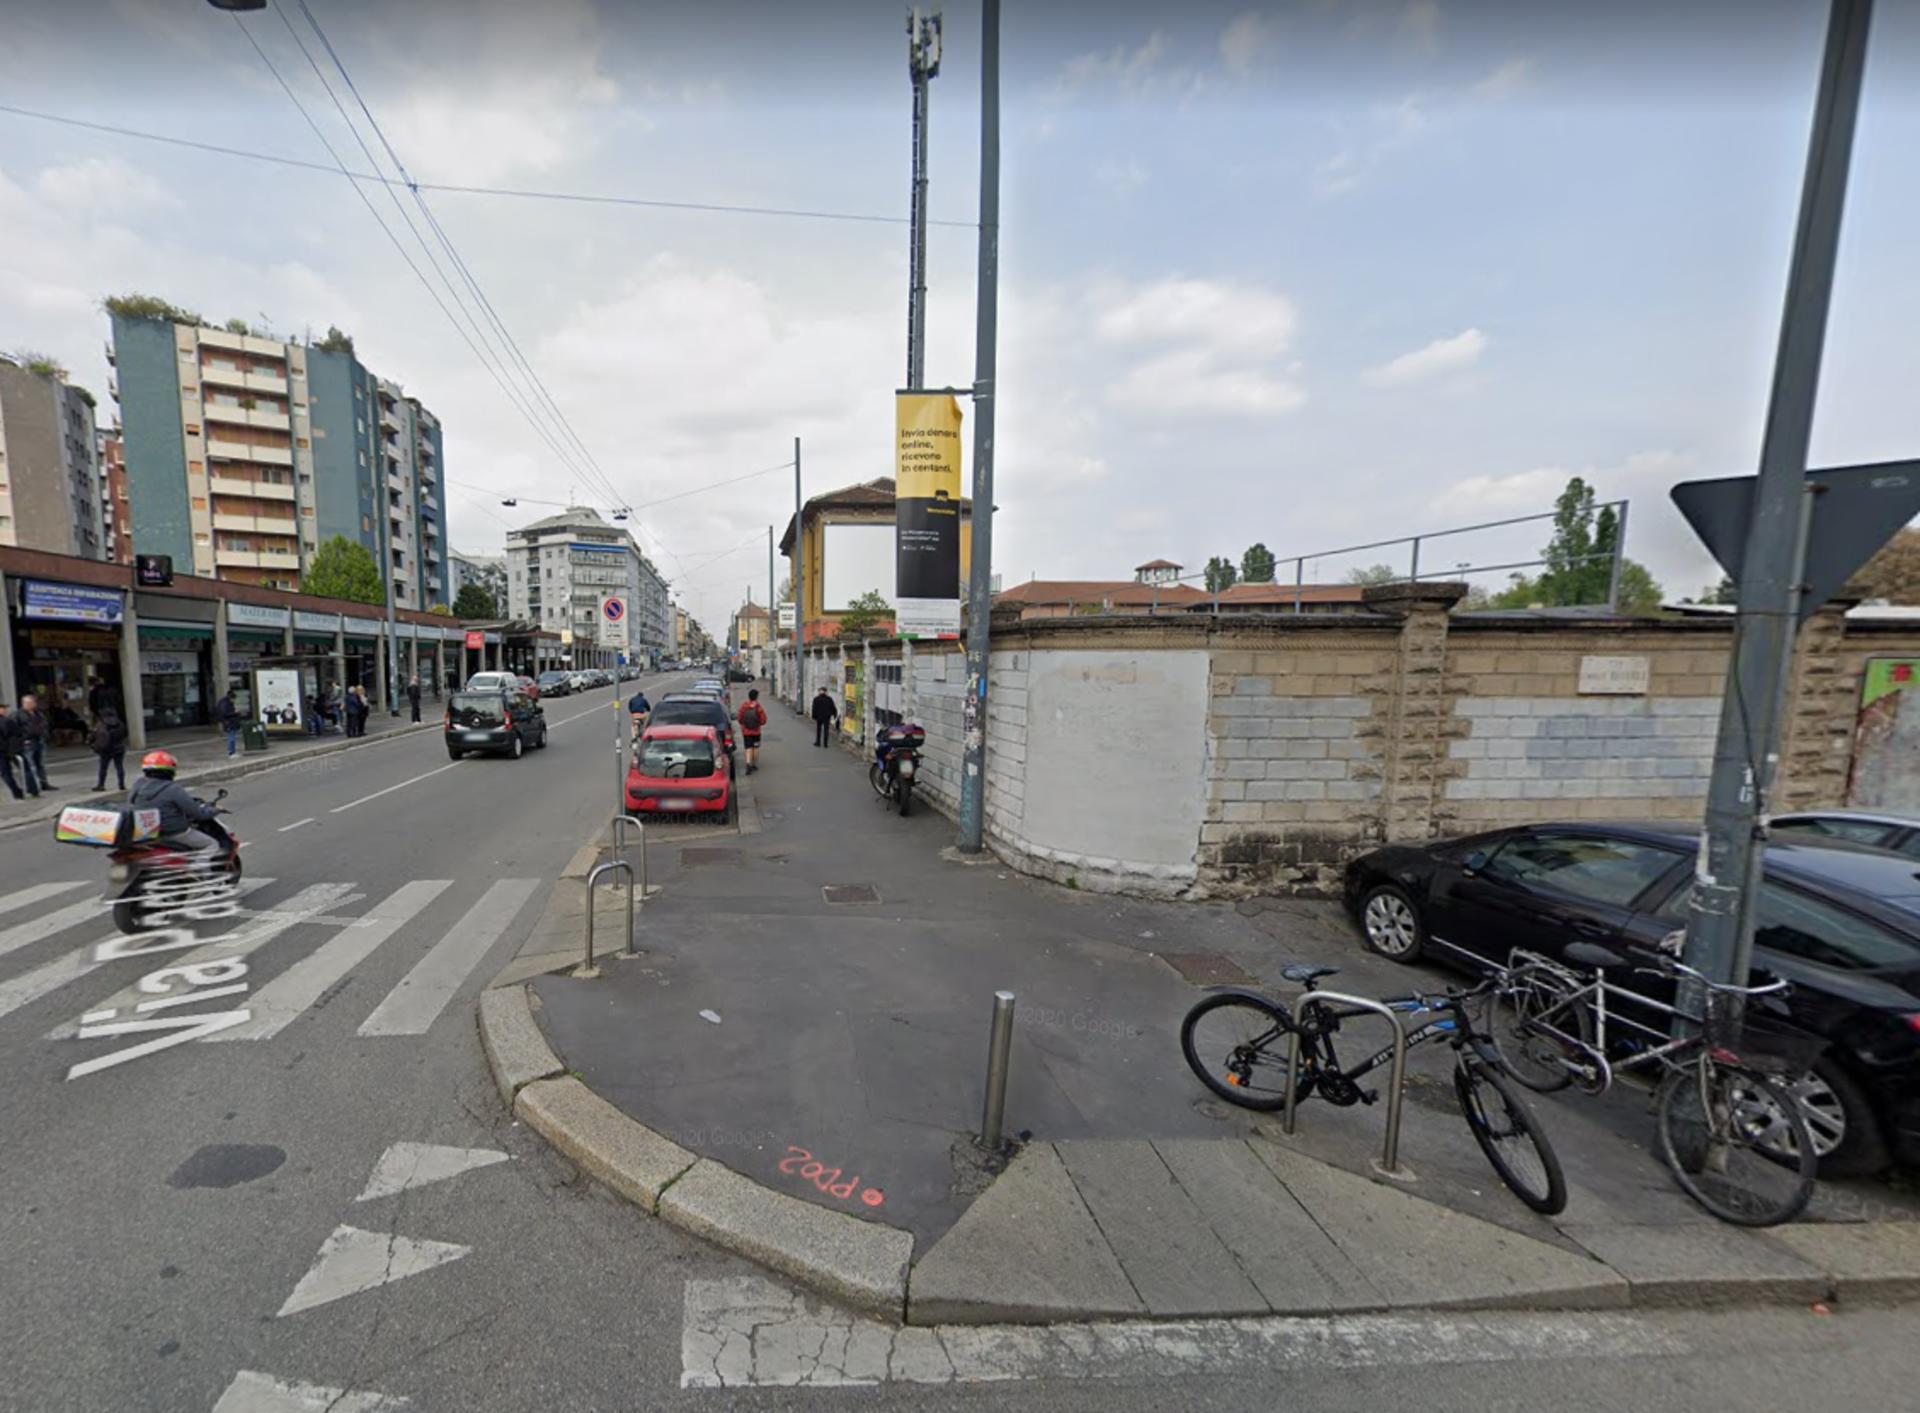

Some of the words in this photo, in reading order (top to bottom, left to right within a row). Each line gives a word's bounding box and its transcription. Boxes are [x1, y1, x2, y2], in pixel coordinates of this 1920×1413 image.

[902, 428, 925, 438] Invia
[902, 440, 934, 449] online,
[902, 464, 911, 472] in
[147, 661, 183, 672] TEMPUR
